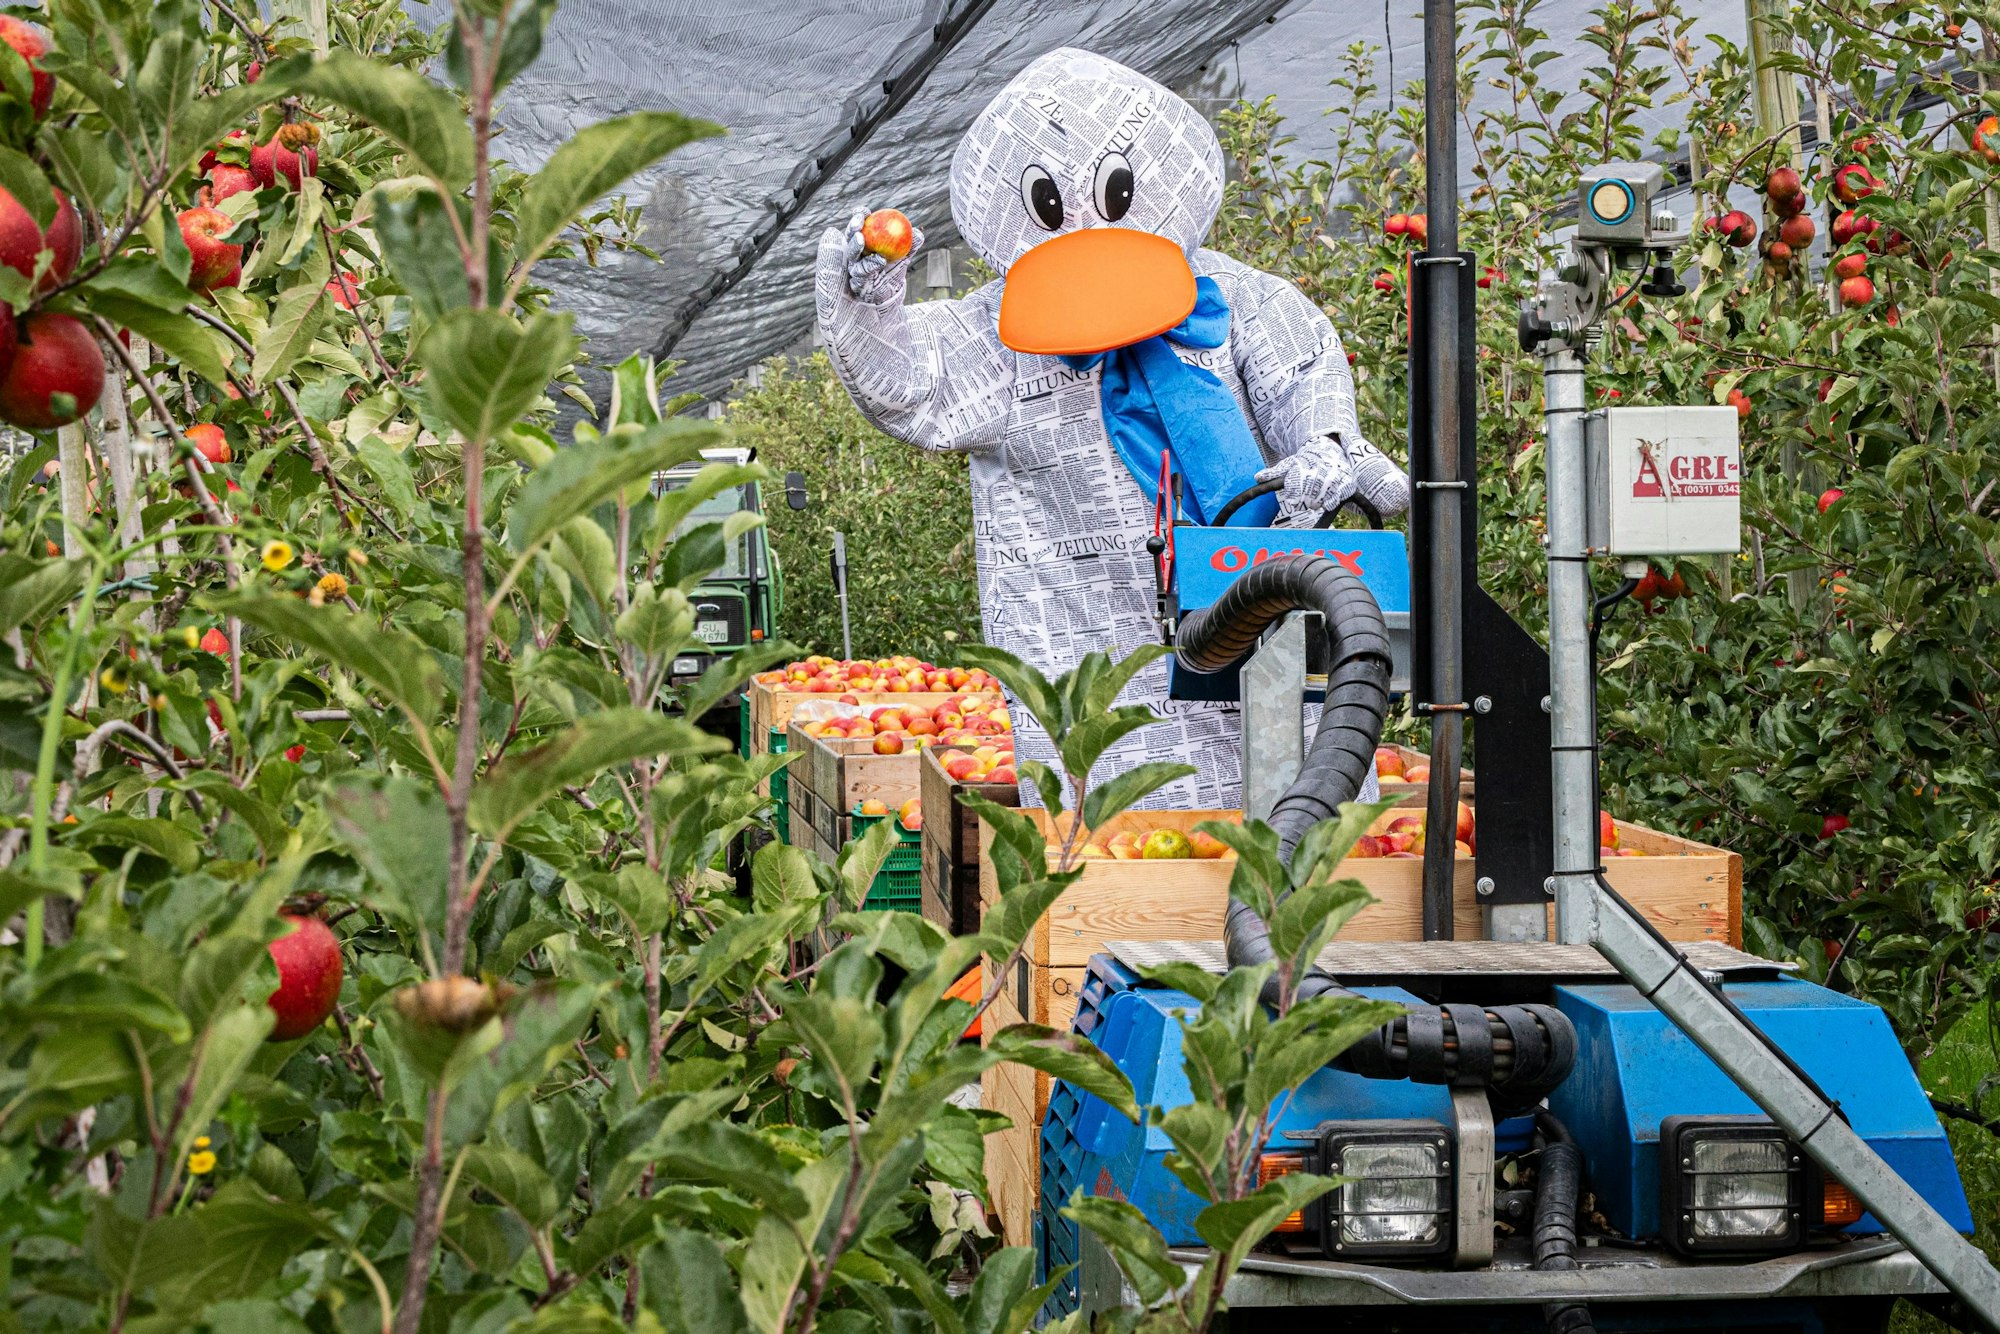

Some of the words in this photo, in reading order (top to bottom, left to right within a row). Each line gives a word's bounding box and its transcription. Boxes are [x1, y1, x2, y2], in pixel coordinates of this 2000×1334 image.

[1013, 370, 1091, 398] EITUNG
[1684, 485, 1713, 495] (0031)
[1053, 533, 1126, 557] ZEITUNG
